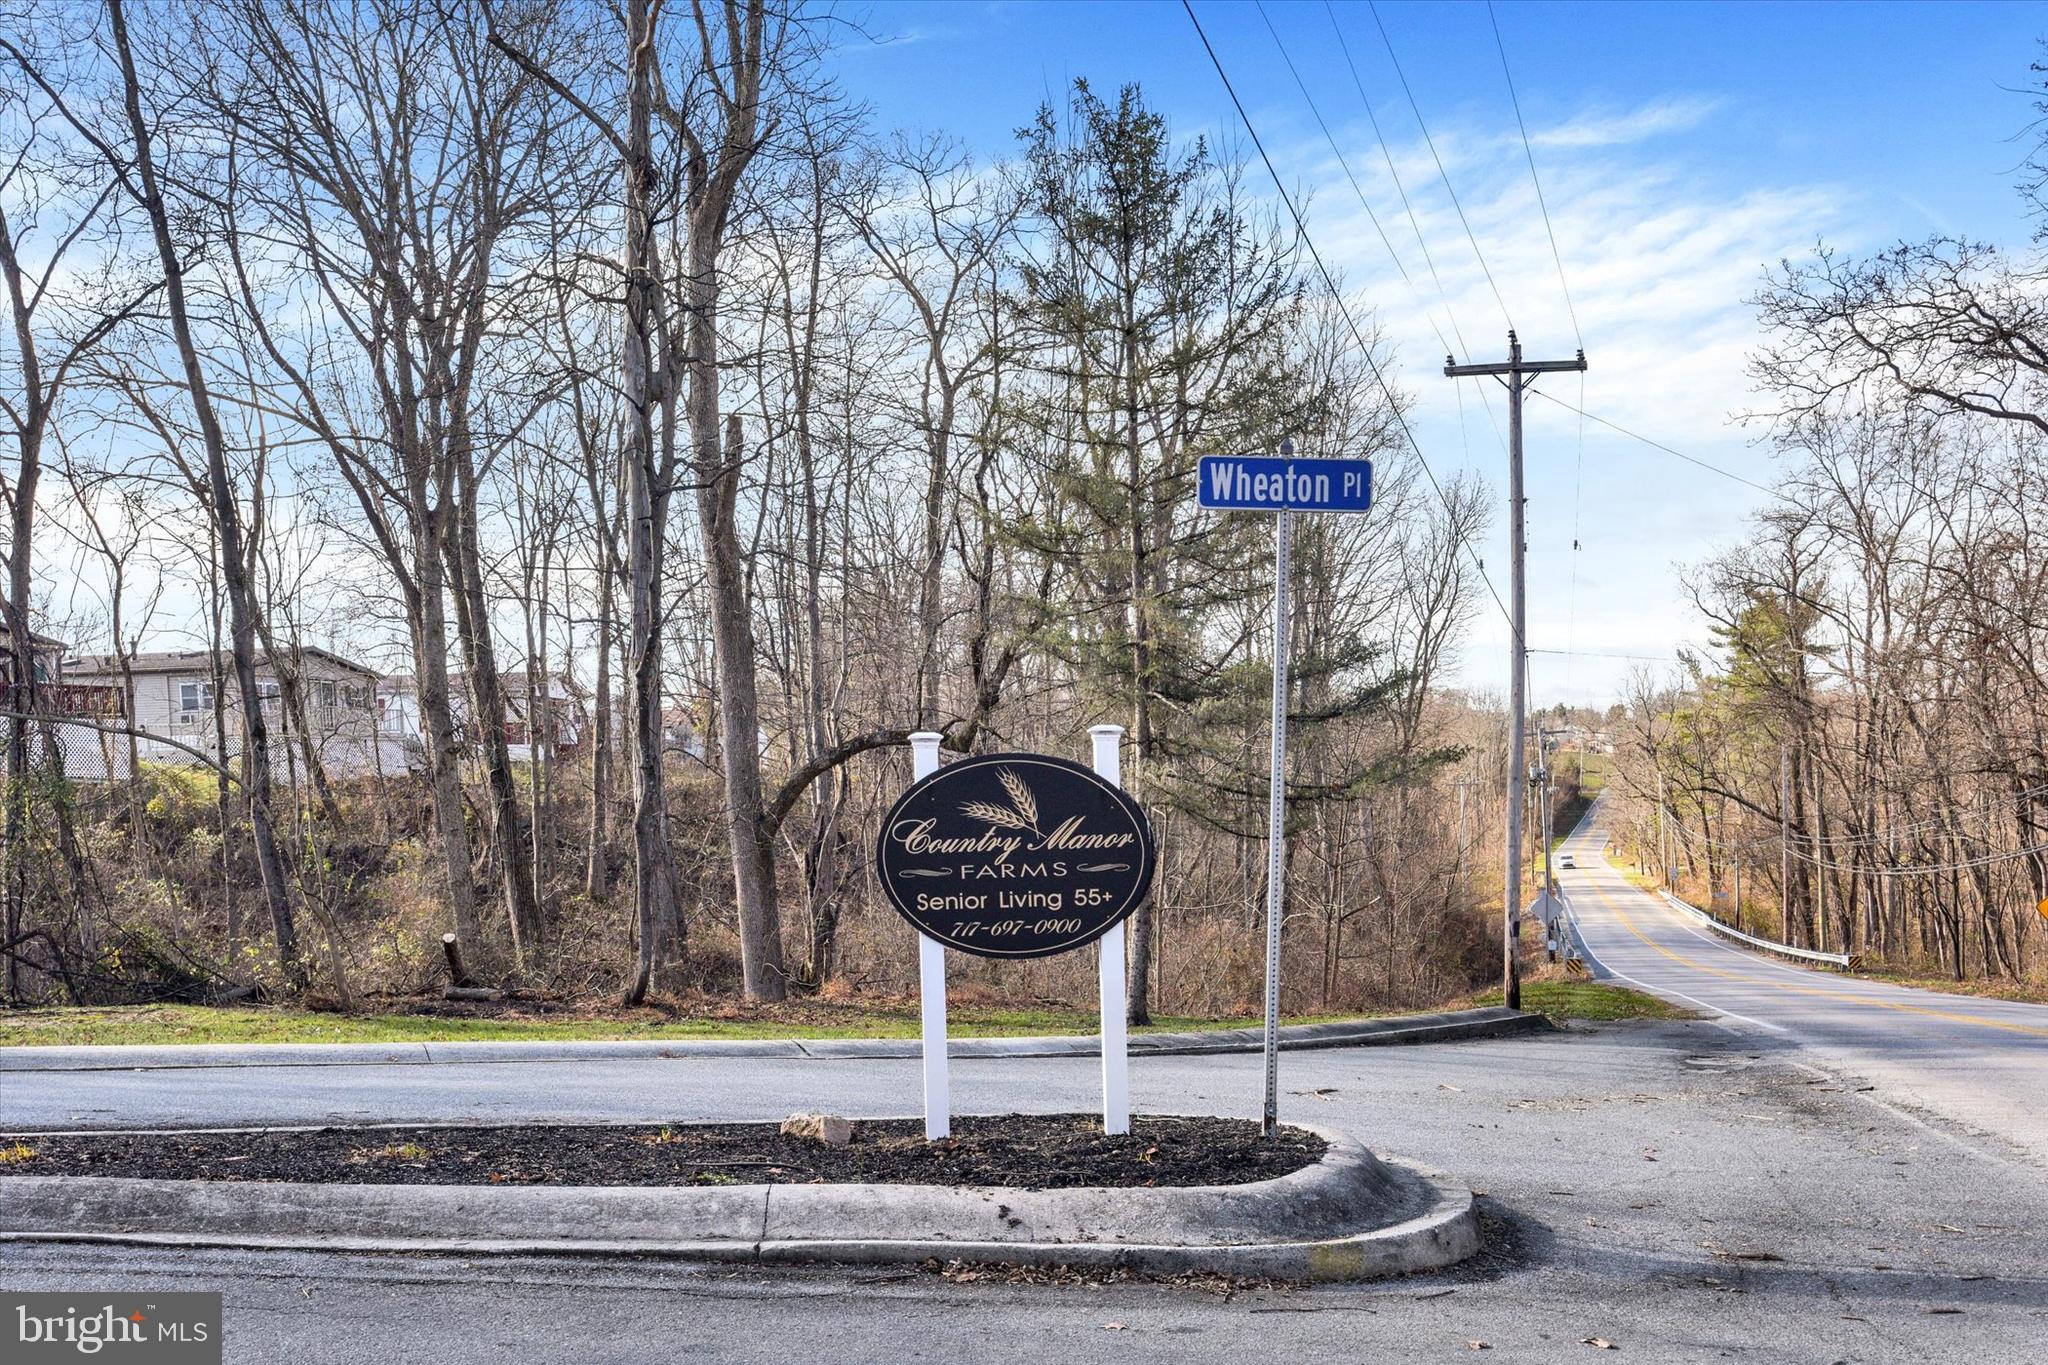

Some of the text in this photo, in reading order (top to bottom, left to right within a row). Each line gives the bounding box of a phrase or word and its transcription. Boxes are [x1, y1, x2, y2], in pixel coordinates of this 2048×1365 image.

[1210, 463, 1361, 503] Wheaton Pl
[892, 815, 1135, 865] Country Manor
[960, 862, 1068, 880] FARMS
[917, 888, 1113, 911] Senior Living 55+
[950, 918, 1082, 937] 717-697-0900
